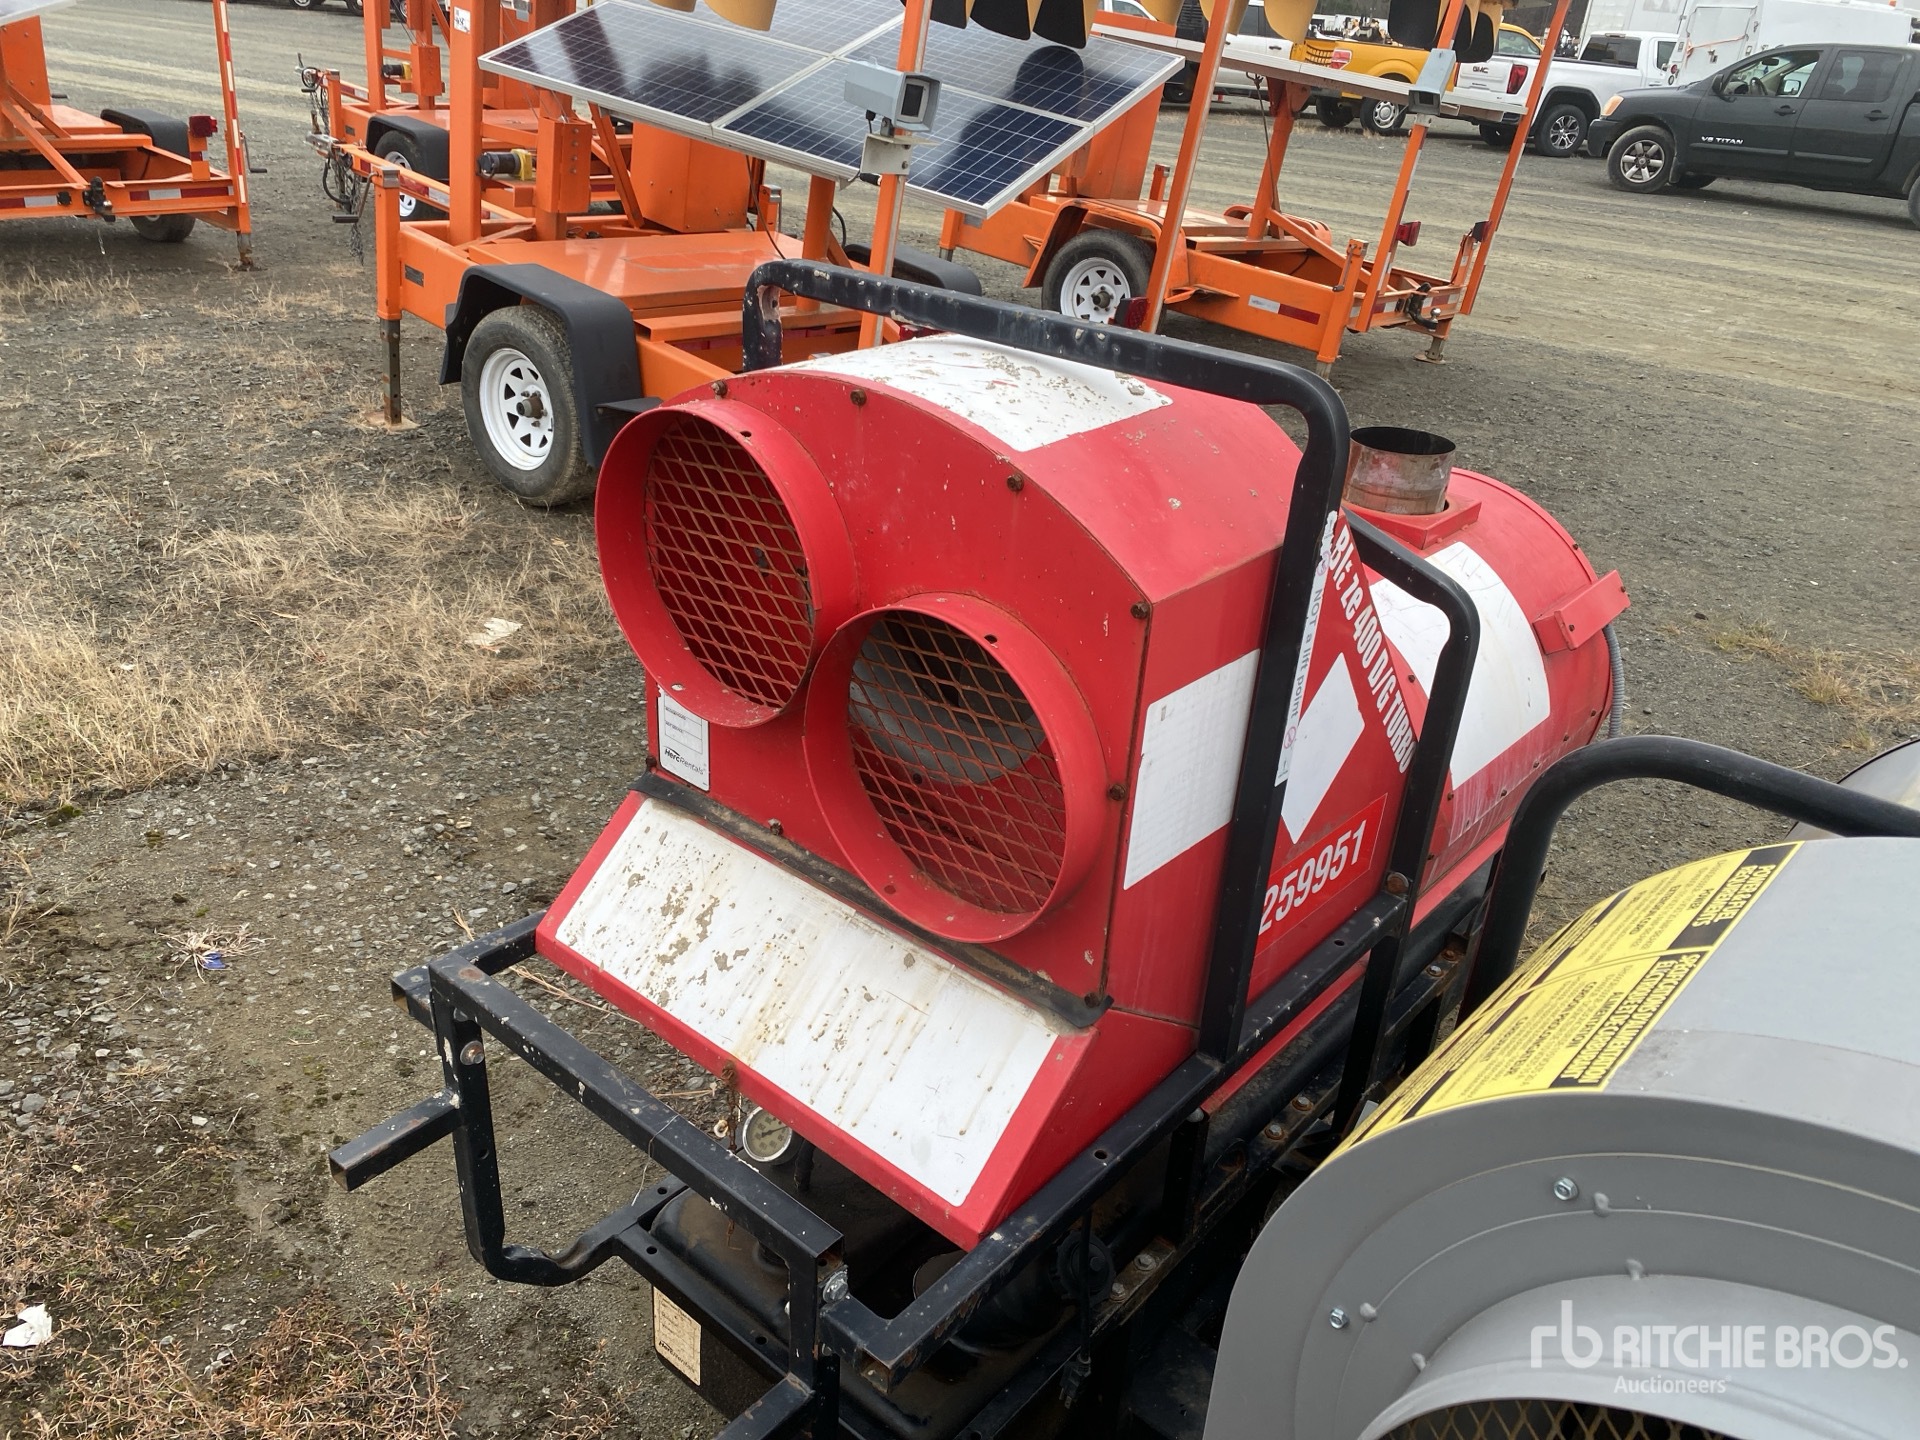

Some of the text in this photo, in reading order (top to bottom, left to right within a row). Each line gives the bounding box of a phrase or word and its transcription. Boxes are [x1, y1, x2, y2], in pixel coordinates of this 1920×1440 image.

[1715, 137, 1744, 145] TITAN
[1291, 588, 1323, 719] NOT a lift point
[1353, 604, 1382, 668] 400
[1367, 648, 1397, 713] D/G
[1382, 689, 1417, 774] TURBO
[1258, 819, 1367, 936] 259951
[1689, 865, 1758, 926] REQUIREMENTS
[1735, 864, 1777, 894] POWER
[1712, 899, 1748, 923] FUEL
[1565, 992, 1625, 1047] ALIMENTATION
